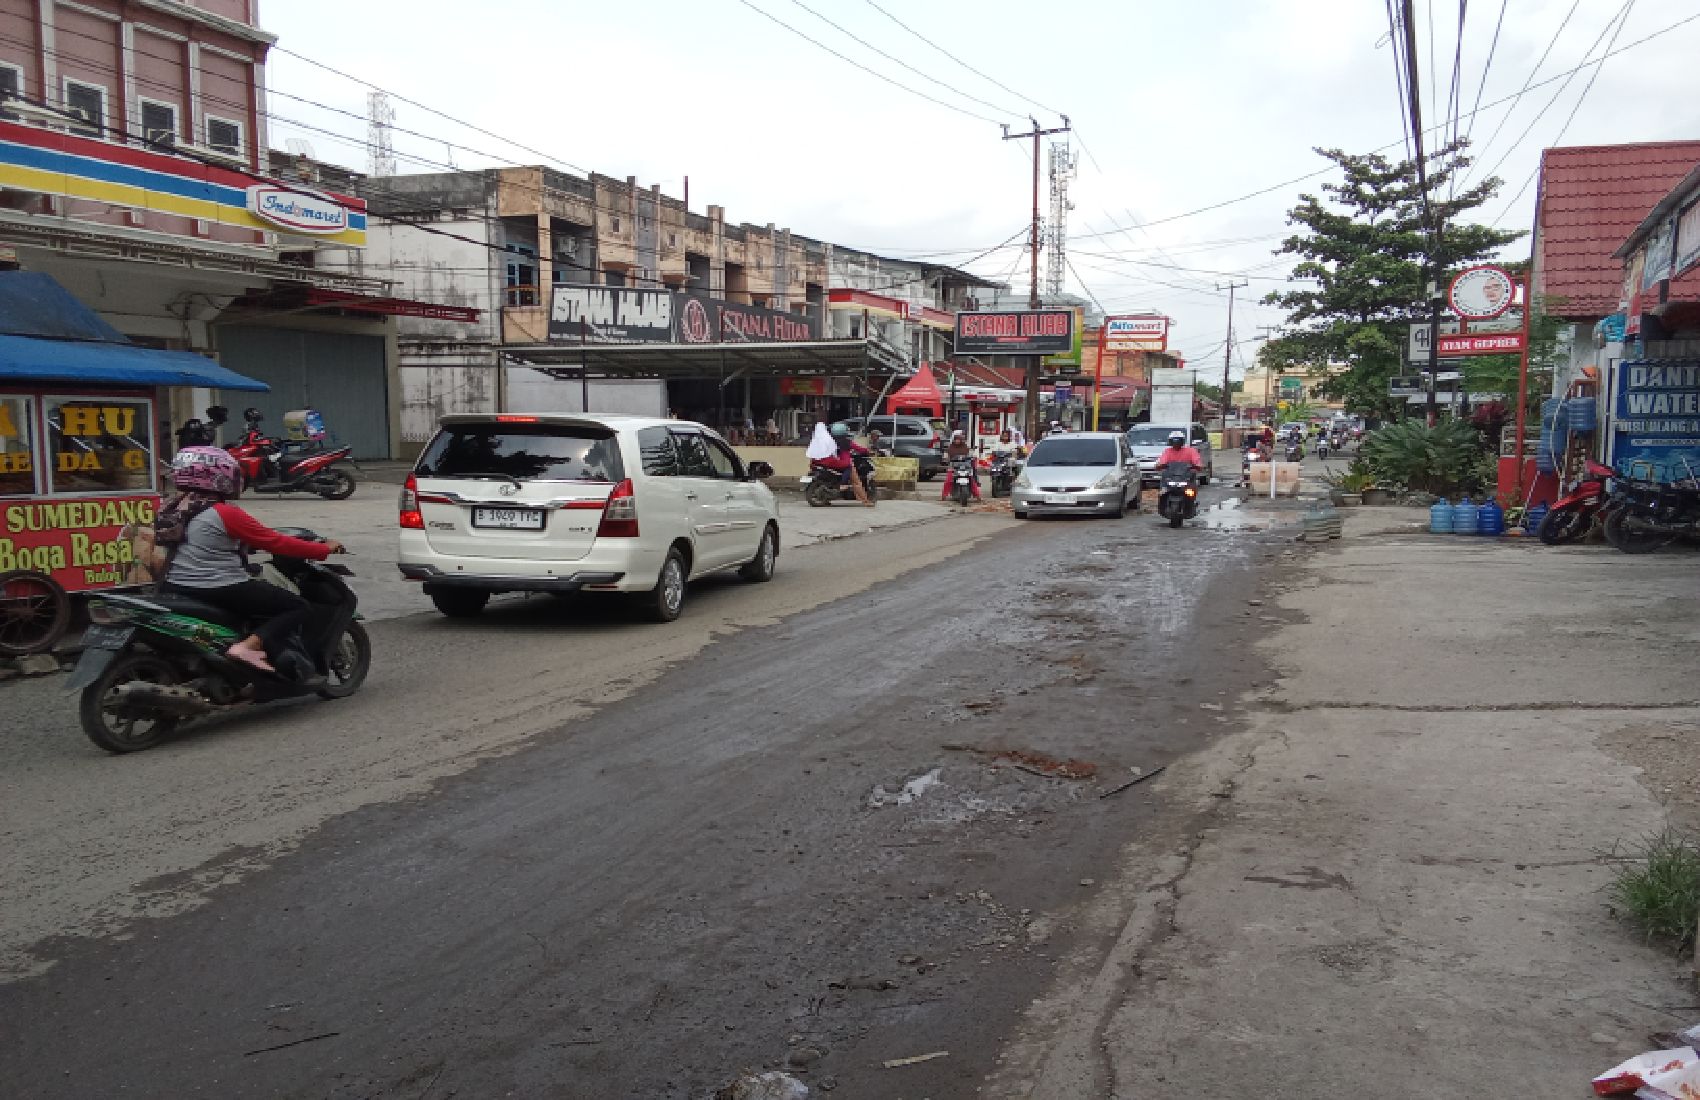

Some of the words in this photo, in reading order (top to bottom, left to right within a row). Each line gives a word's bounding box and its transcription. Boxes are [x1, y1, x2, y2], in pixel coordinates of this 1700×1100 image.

[960, 314, 1018, 337] ISTANA
[1020, 314, 1069, 337] HIJAB
[1629, 393, 1700, 414] WATE
[6, 500, 153, 533] SUMEDANG
[70, 533, 134, 567] Rasa
